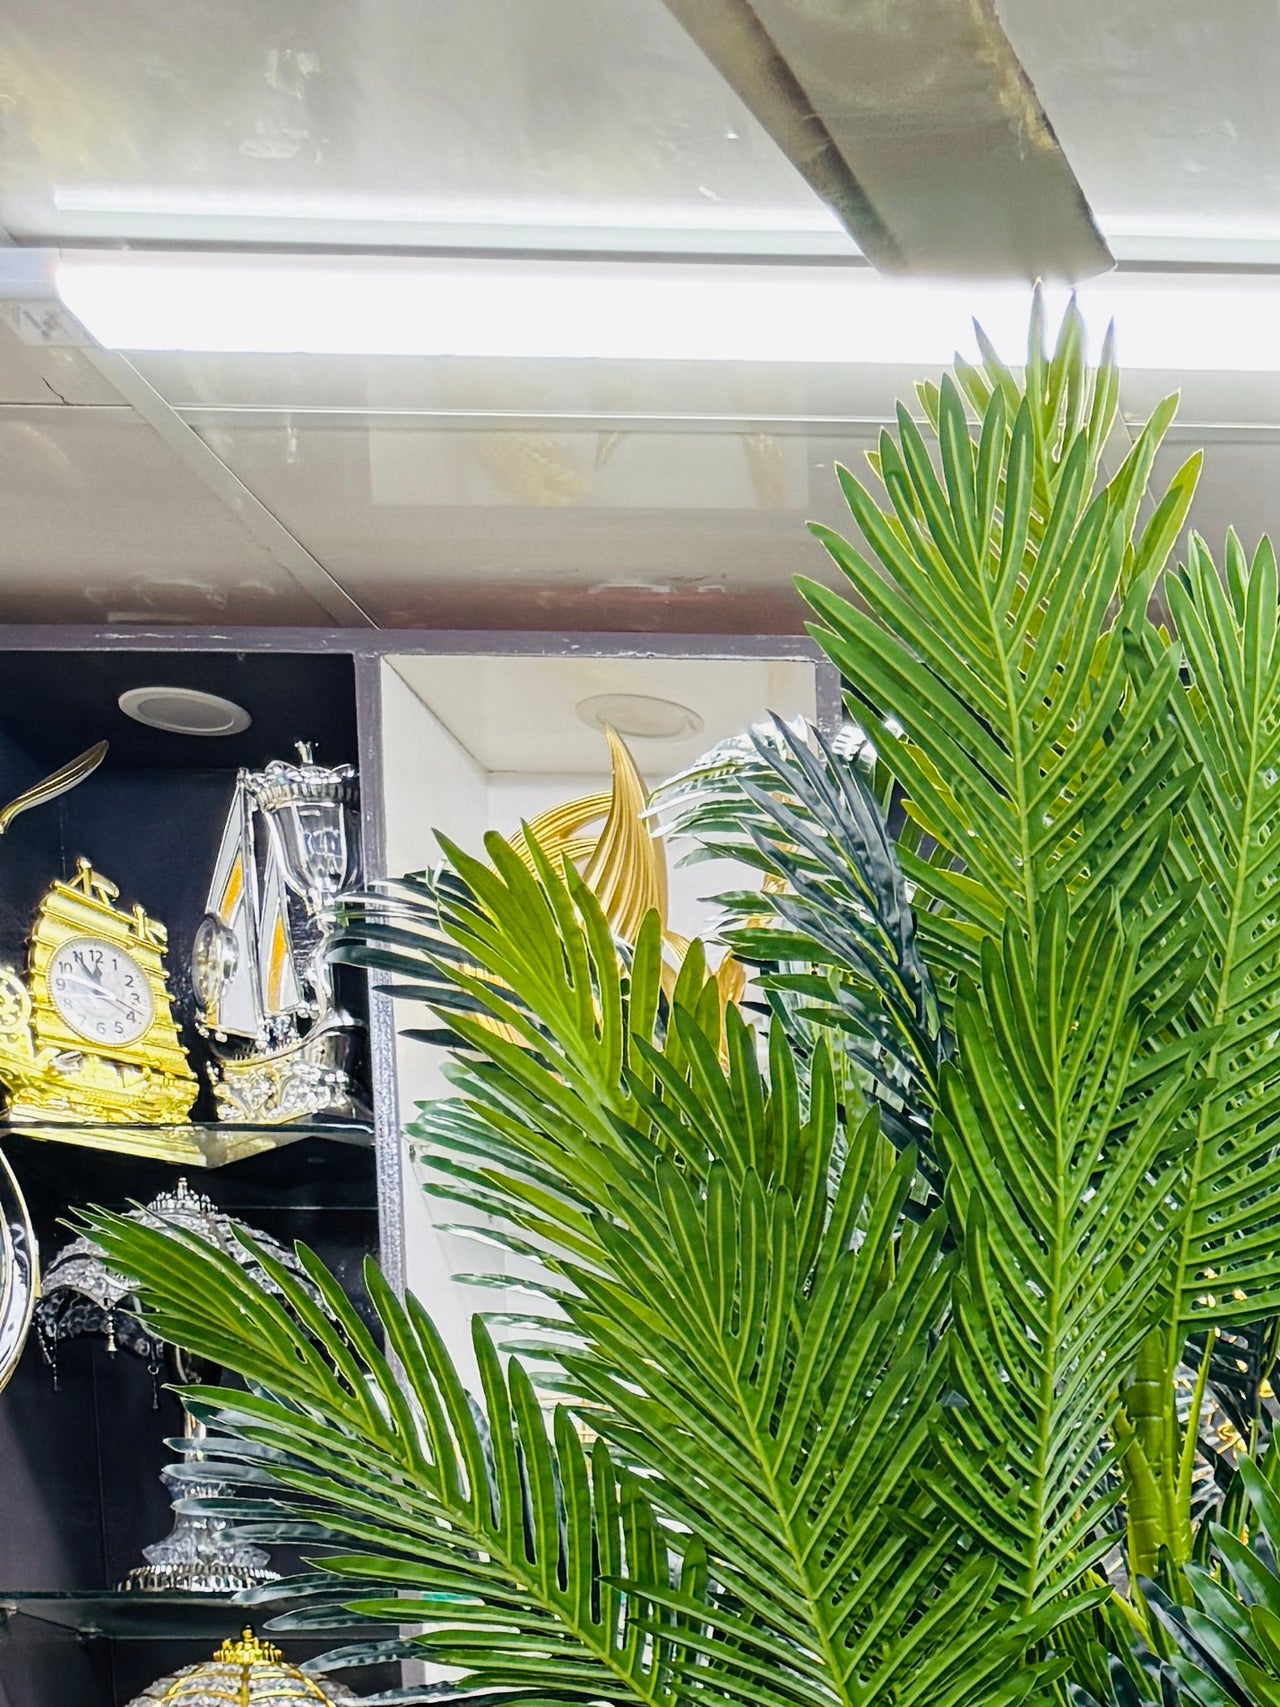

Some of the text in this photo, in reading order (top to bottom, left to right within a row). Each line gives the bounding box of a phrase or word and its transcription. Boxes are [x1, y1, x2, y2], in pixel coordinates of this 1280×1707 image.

[88, 949, 105, 964] 12
[58, 961, 74, 974] 10
[112, 958, 119, 971] 1
[55, 978, 67, 991] 9
[124, 974, 136, 988] 2
[130, 992, 141, 1006] 3
[126, 1011, 138, 1024] 4
[96, 1022, 107, 1035] 6
[114, 1021, 125, 1035] 5
